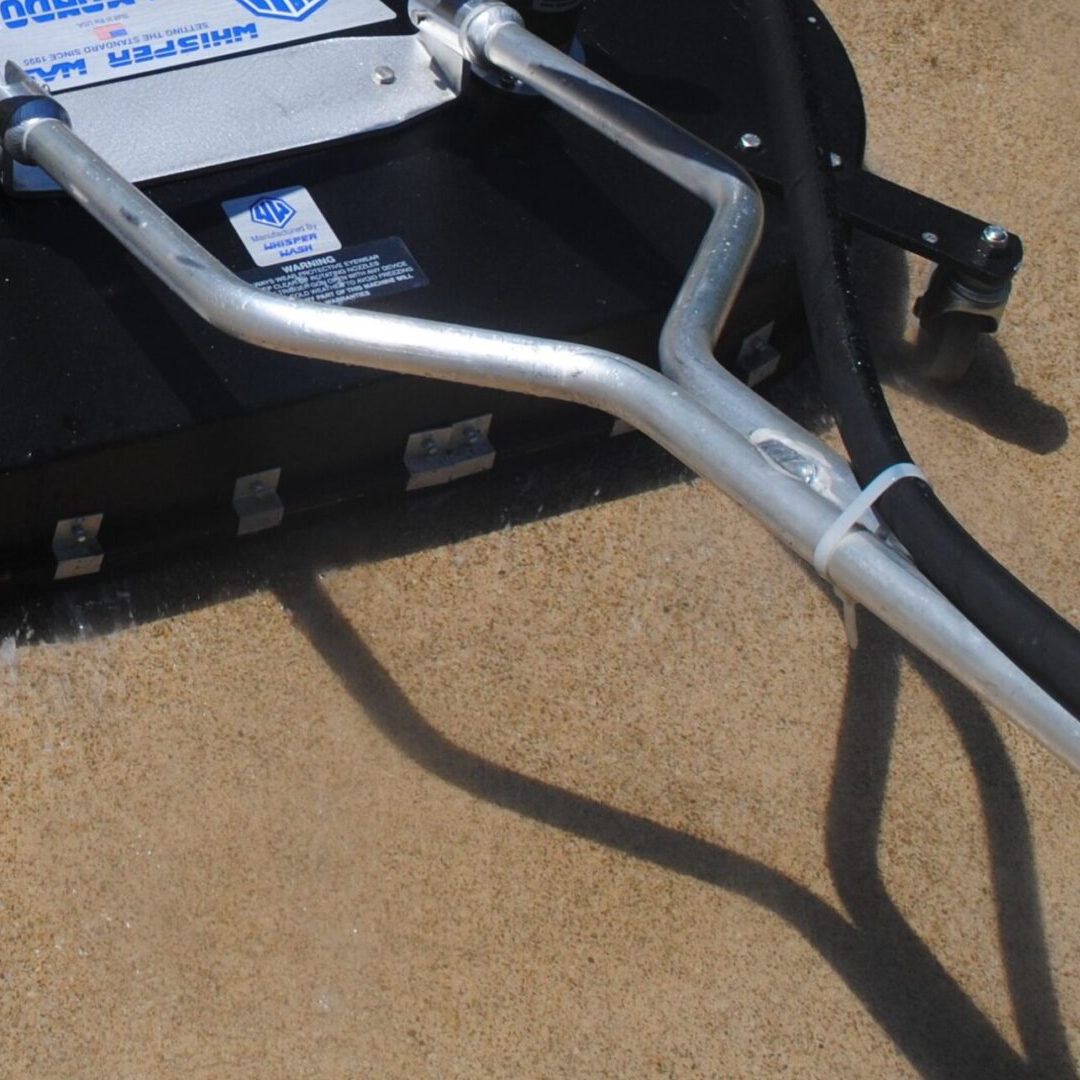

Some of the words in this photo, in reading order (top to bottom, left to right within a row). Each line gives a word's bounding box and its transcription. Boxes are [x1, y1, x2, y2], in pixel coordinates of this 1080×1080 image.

[142, 30, 163, 42] THE
[165, 22, 209, 37] SETTING
[83, 34, 141, 54] STANDARD
[108, 23, 258, 68] WHISPER
[50, 46, 82, 61] SINCE
[25, 58, 88, 83] WA
[264, 232, 318, 251] WHISPER
[279, 244, 313, 258] WASH
[275, 273, 299, 283] WEAR
[298, 263, 343, 276] PROTECTIVE
[344, 254, 380, 266] EYEWEAR
[281, 255, 336, 274] WARNING
[310, 269, 346, 281] ROTATING
[346, 261, 380, 272] NOZZLES
[378, 266, 414, 278] FREEZING
[381, 261, 408, 271] DEVICE
[395, 273, 414, 281] WILL
